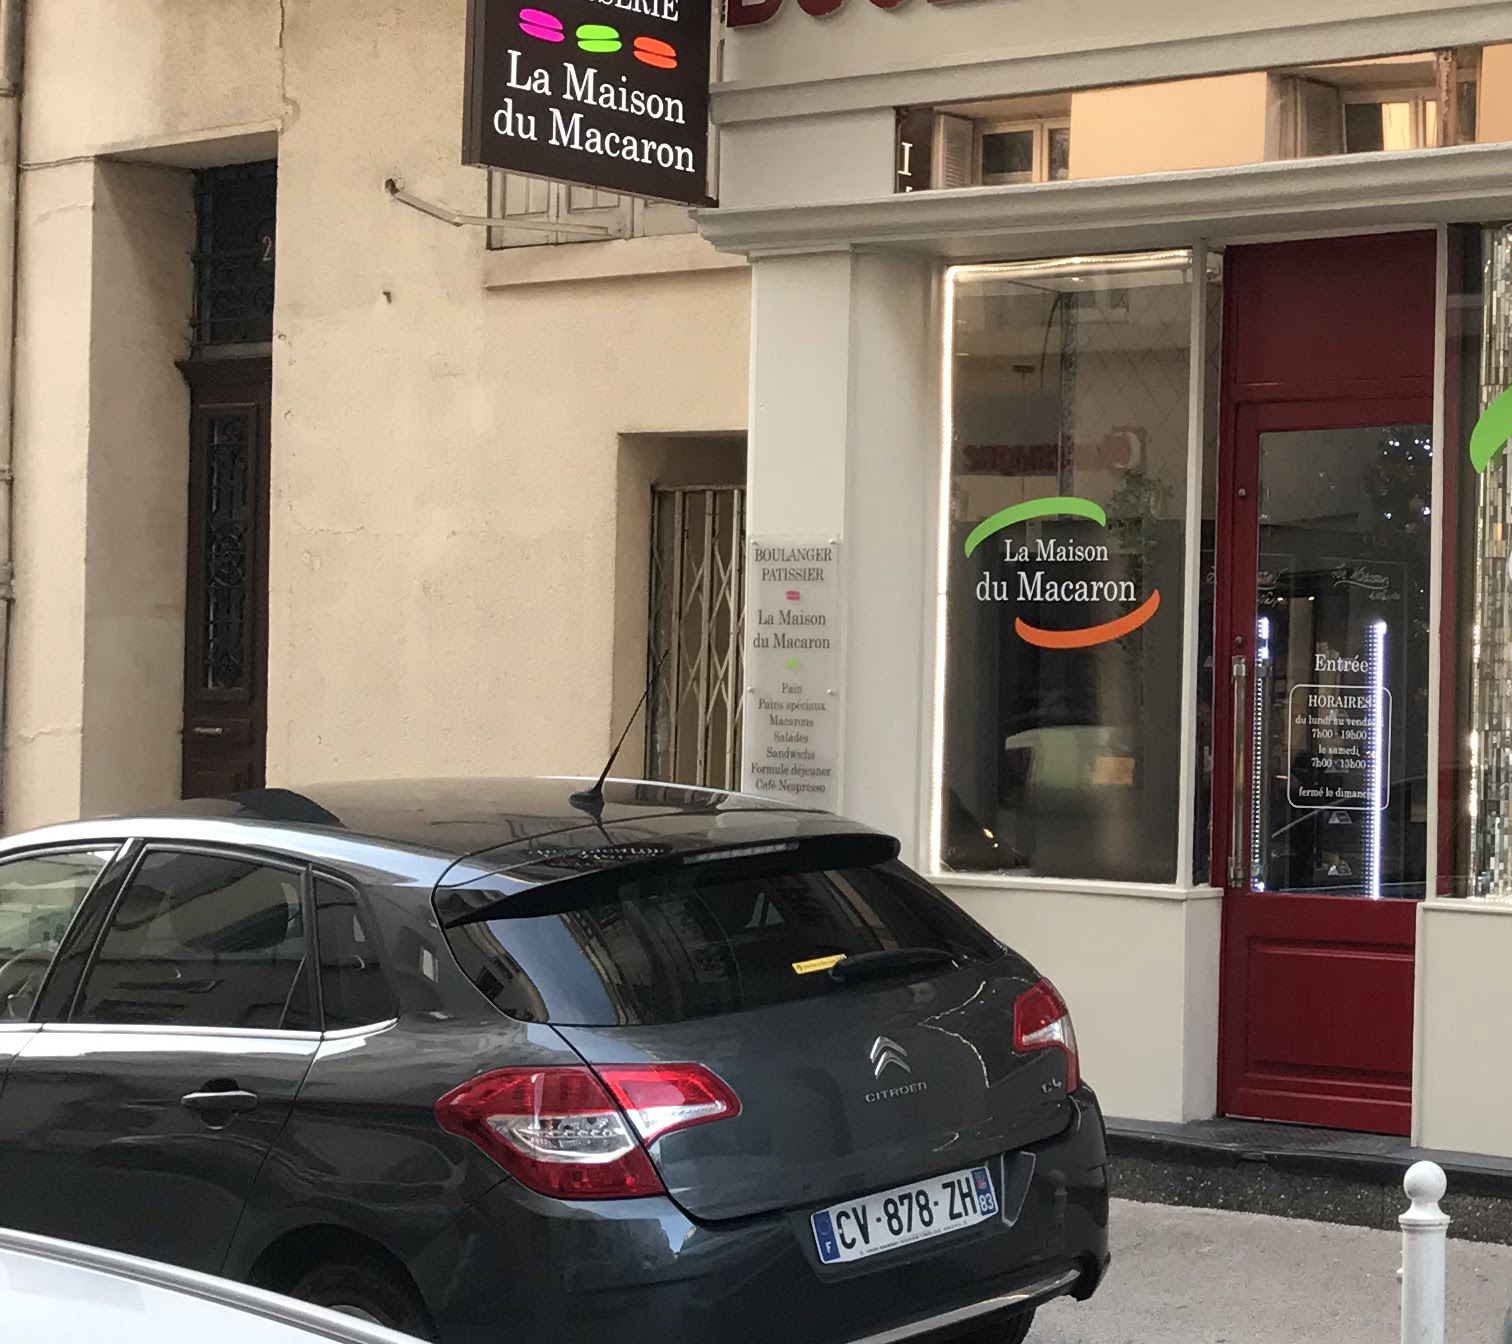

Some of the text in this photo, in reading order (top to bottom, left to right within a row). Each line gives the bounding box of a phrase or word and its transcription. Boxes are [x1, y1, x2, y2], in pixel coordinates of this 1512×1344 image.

[506, 49, 686, 124] La Maison
[494, 98, 696, 173] du Macaron
[754, 548, 832, 562] BOULANGER
[1004, 538, 1109, 562] La Maison
[761, 568, 825, 582] PATISSIER
[976, 571, 1137, 602] du Macaron
[758, 609, 827, 626] La Maison
[753, 632, 831, 649] du Macaron
[1314, 654, 1370, 674] Entrée
[782, 682, 803, 695] Pain
[758, 698, 826, 712] Pains spéciaux
[769, 713, 814, 727] Macarons
[1295, 714, 1307, 725] du
[1308, 714, 1331, 725] lundi
[1333, 717, 1344, 726] au
[773, 730, 809, 743] Salades
[1311, 728, 1333, 739] 7h00
[1340, 729, 1367, 740] 19h00
[1318, 744, 1328, 754] le
[751, 762, 832, 778] Formule déjeuner
[1311, 757, 1332, 768] 7h00
[1340, 758, 1367, 769] 13h00
[755, 778, 826, 794] Café Nespresso
[1298, 786, 1324, 797] fermé
[1325, 786, 1333, 797] le
[978, 1192, 994, 1212] 83
